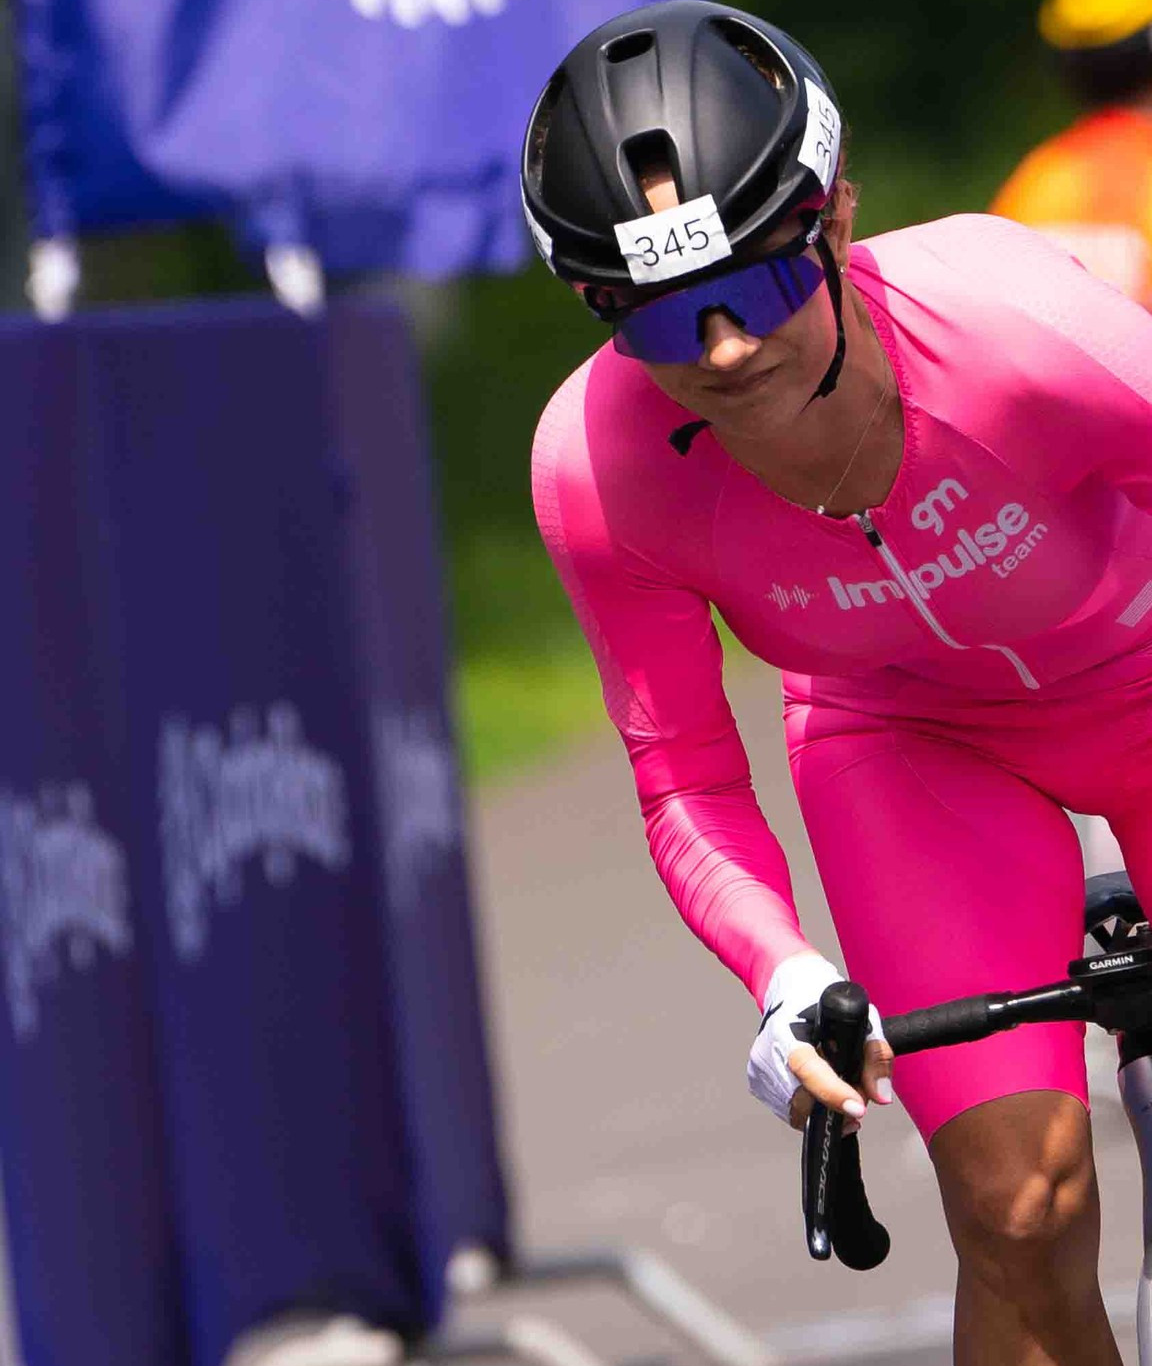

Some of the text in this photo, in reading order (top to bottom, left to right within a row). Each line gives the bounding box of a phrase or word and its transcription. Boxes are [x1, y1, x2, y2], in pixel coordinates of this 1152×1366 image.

[815, 98, 835, 167] 345
[634, 218, 710, 266] 345
[828, 502, 1029, 609] Impulse
[992, 522, 1048, 578] team
[1089, 955, 1134, 970] GARMIN
